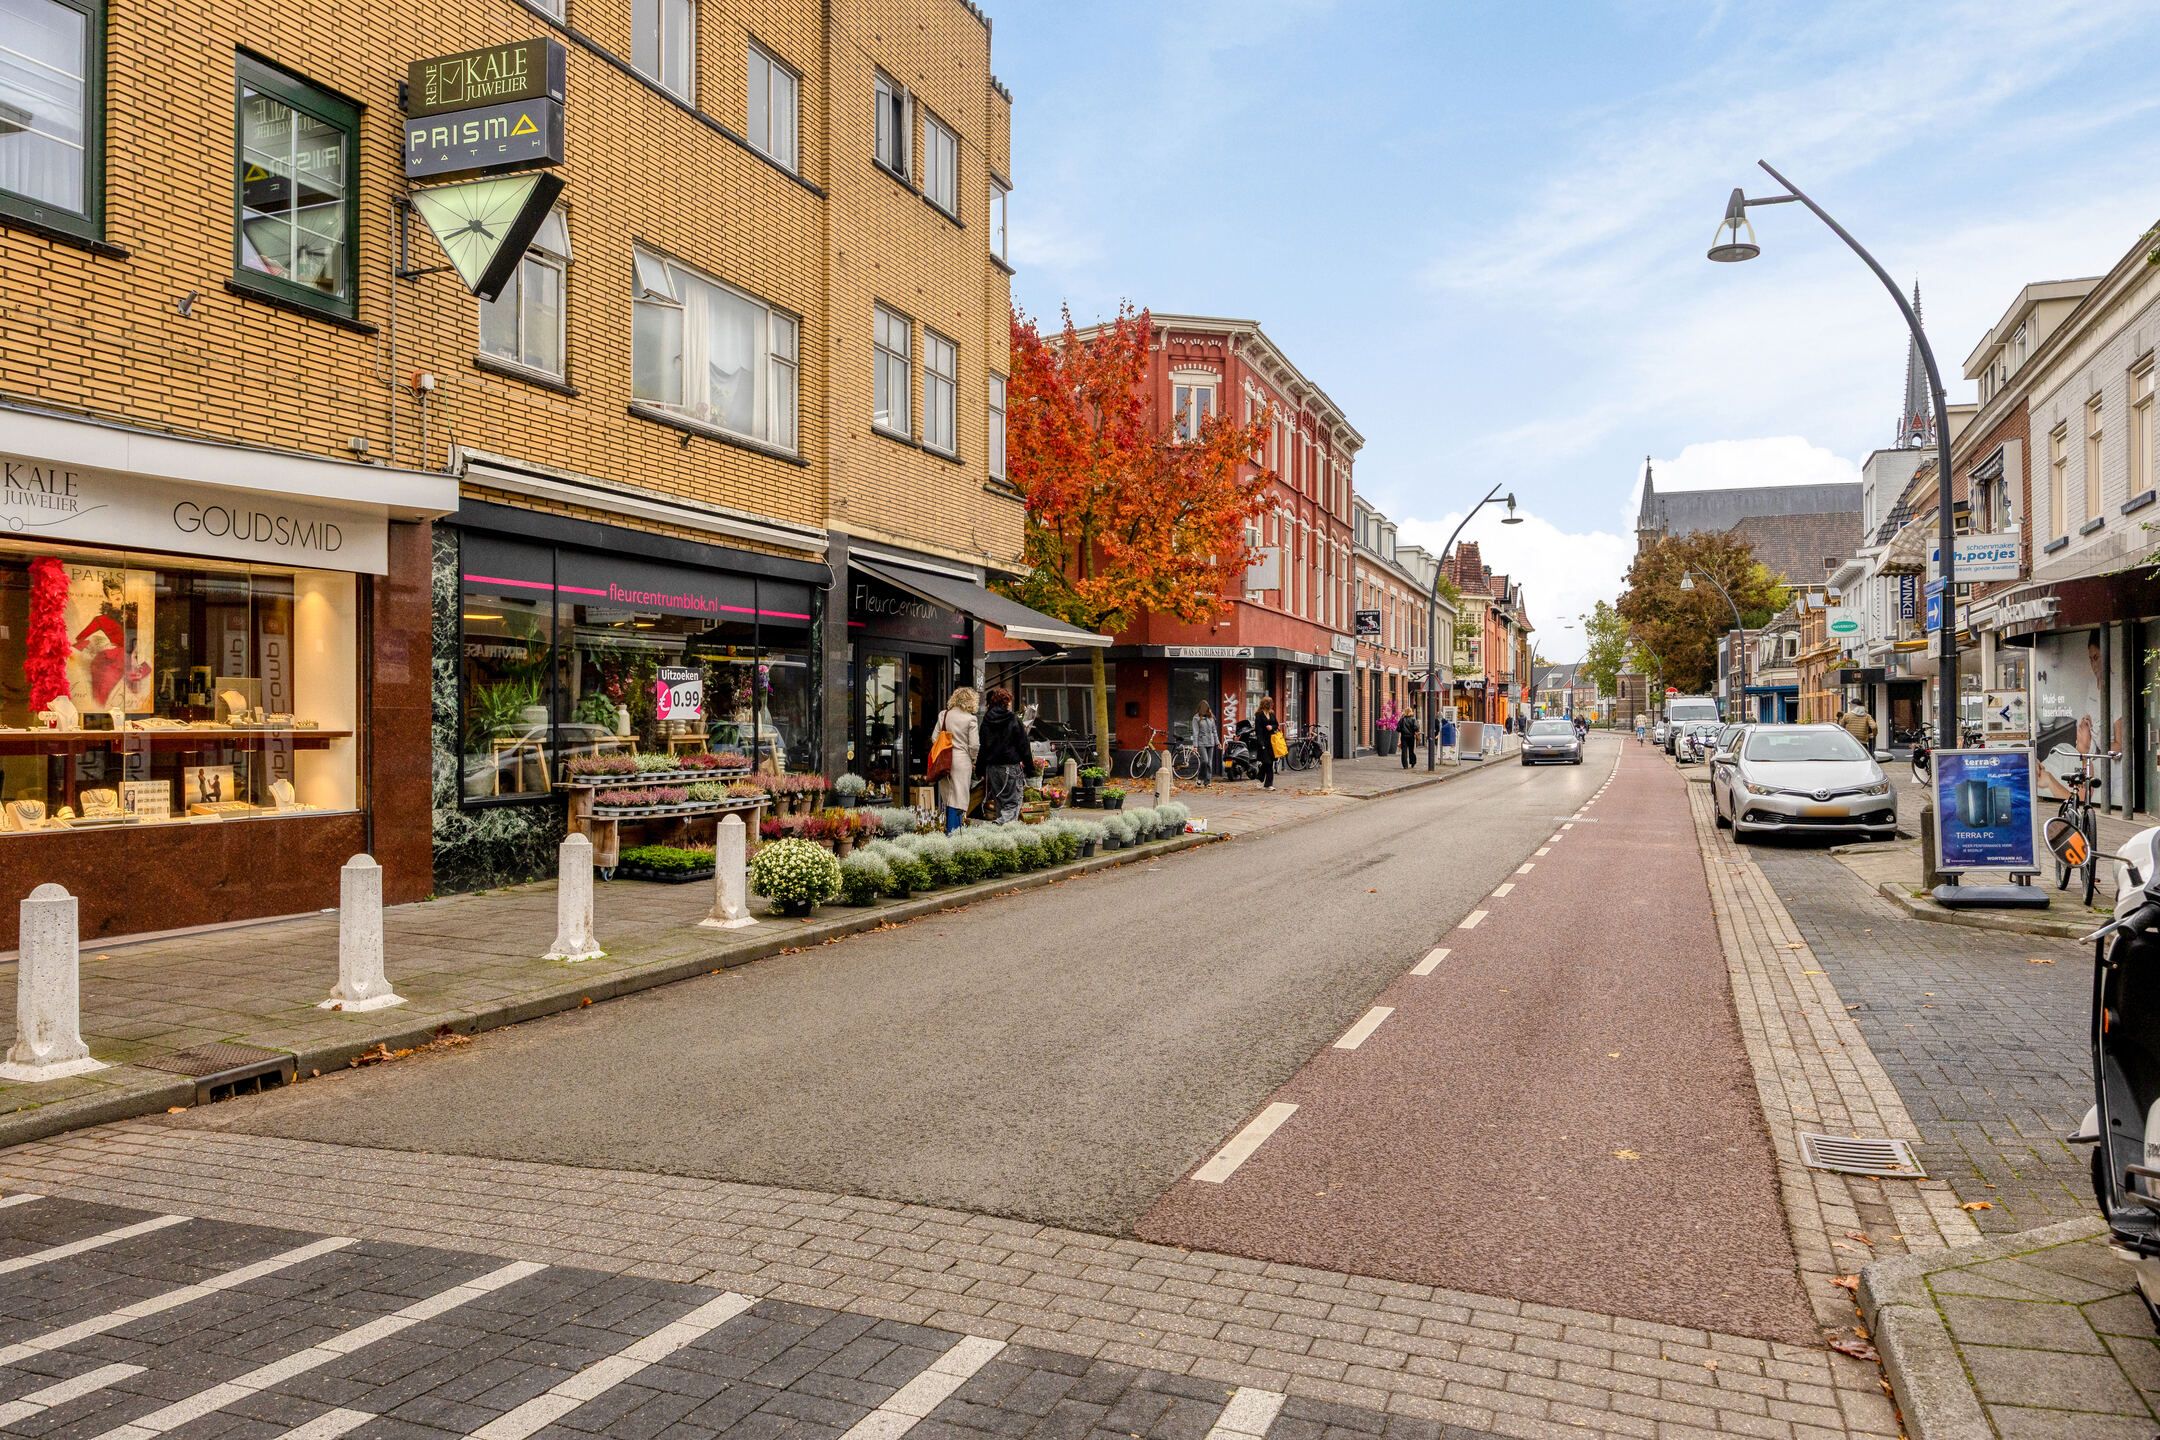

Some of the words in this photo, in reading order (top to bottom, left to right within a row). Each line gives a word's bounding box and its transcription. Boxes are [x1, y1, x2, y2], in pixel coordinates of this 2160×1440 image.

[466, 48, 528, 84] KALE
[465, 76, 529, 102] JUWELIER
[4, 462, 79, 498] KALE
[3, 489, 79, 513] JUWELIER
[173, 501, 343, 552] GOUDSMID
[1966, 543, 2015, 551] schoenmaker
[71, 567, 126, 585] PARIS
[609, 582, 719, 613] fleurcentrumblok.nl
[661, 669, 699, 681] Uitzoeken
[1964, 757, 1989, 766] terra
